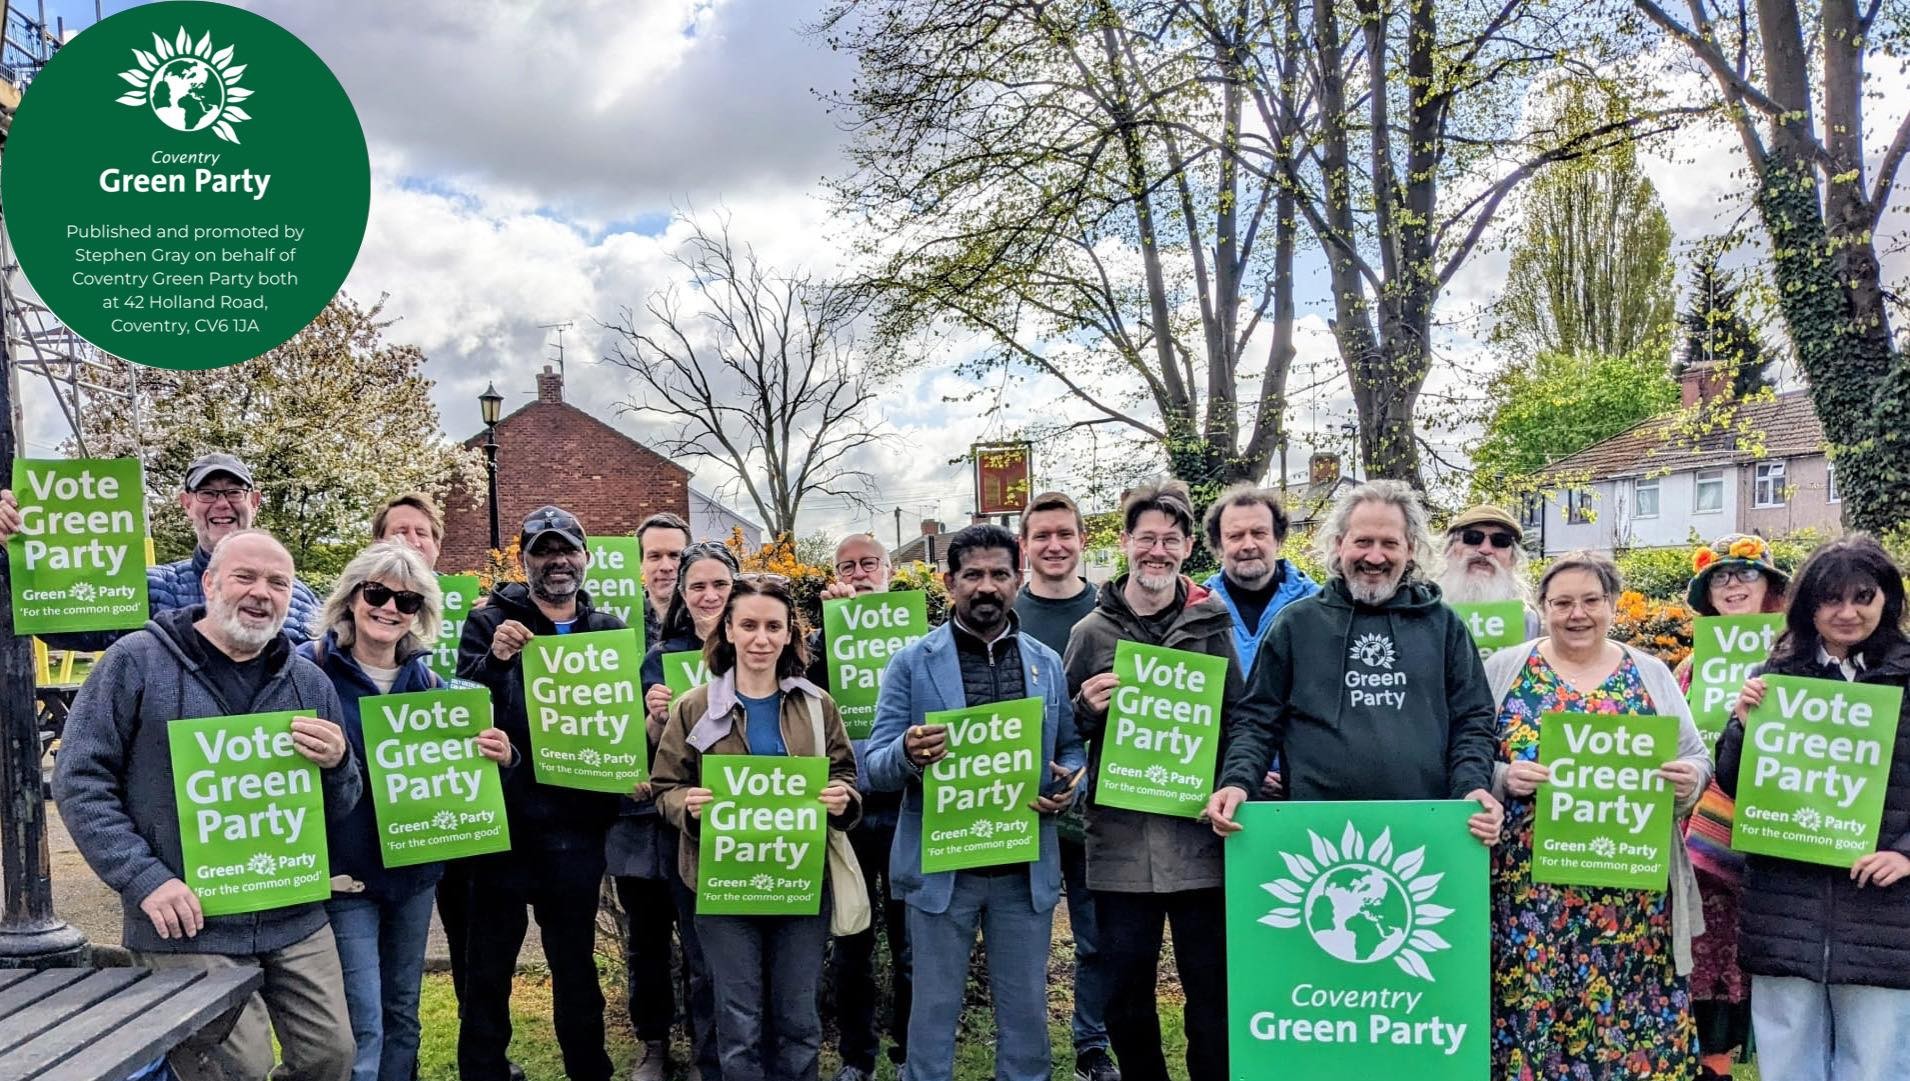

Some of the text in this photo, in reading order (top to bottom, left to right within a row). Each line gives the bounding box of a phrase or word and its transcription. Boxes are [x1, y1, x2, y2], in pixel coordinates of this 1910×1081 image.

[26, 470, 119, 500] Vote
[18, 506, 134, 536] Green
[24, 539, 128, 576] Party
[586, 545, 624, 570] te
[23, 585, 136, 601] Green Party
[584, 578, 635, 597] een
[43, 606, 61, 616] the
[63, 605, 110, 614] common
[840, 602, 910, 631] Vote
[1468, 611, 1505, 637] te
[1713, 624, 1775, 653] Vot
[539, 644, 619, 674] Vote
[1134, 654, 1206, 692] Vote
[532, 677, 634, 705] Green
[840, 664, 885, 690] Par
[1345, 670, 1407, 688] Green
[839, 705, 872, 715] Green
[1116, 686, 1212, 726] Green
[1350, 690, 1406, 710] Party
[1776, 686, 1873, 727] Vote
[382, 702, 470, 733] Vote
[540, 707, 629, 745] Party
[946, 713, 1022, 747] Vote
[194, 726, 294, 764] Vote
[375, 737, 485, 769] Green
[1115, 718, 1204, 764] Party
[1563, 723, 1655, 757] Vote
[1754, 722, 1881, 766] Green
[541, 747, 637, 766] Green Party
[556, 764, 572, 774] the
[574, 767, 613, 777] common
[932, 749, 1033, 782] Green
[186, 768, 312, 804] Green
[386, 765, 482, 804] Party
[723, 766, 807, 796] Vote
[1107, 763, 1203, 789] Green Party
[1549, 757, 1664, 792] Green
[1754, 756, 1867, 808] Party
[937, 778, 1025, 814] Party
[1119, 782, 1135, 793] the
[1136, 786, 1178, 799] common
[197, 802, 306, 844] Party
[388, 810, 495, 835] Green Party
[710, 801, 817, 831] Green
[1551, 791, 1655, 834] Party
[1745, 805, 1866, 836] Green Party
[408, 837, 426, 848] the
[428, 831, 472, 846] common
[931, 819, 1029, 842] Green Party
[1762, 825, 1780, 838] the
[1782, 830, 1833, 846] common
[714, 835, 810, 870] Party
[946, 844, 961, 854] the
[963, 840, 1005, 852] common
[1544, 839, 1658, 859] Green Party
[197, 853, 316, 879] Green Party
[1560, 856, 1579, 867] the
[1580, 859, 1628, 871] common
[219, 883, 239, 895] the
[242, 878, 291, 892] common
[707, 877, 811, 890] Green Party
[724, 892, 741, 901] the
[1291, 983, 1423, 1014] Coventry
[1250, 1011, 1467, 1055] Green Party
